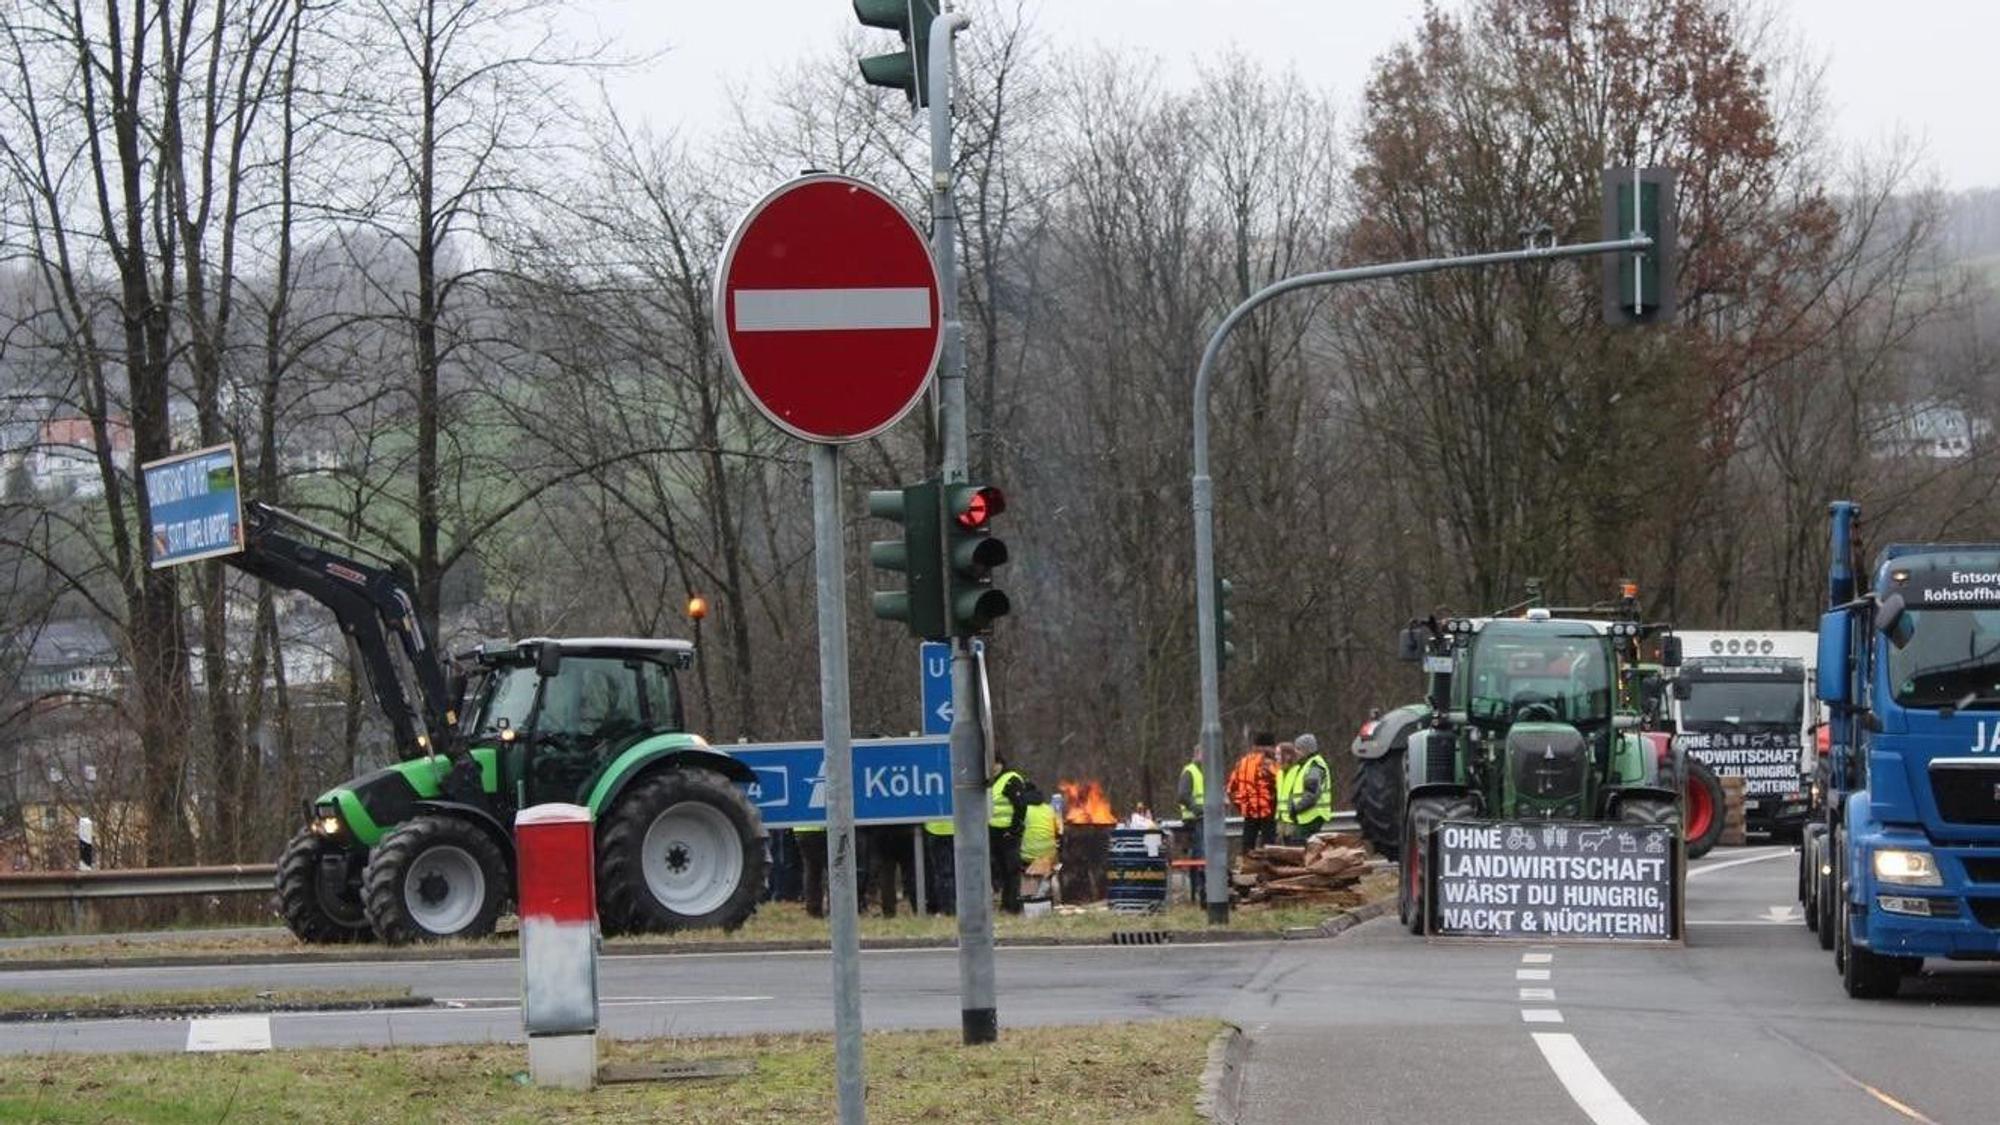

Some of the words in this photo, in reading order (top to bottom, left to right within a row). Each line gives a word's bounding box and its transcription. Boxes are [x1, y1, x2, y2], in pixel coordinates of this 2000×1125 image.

[864, 765, 944, 798] Köln
[1444, 827, 1502, 850] OHNE
[1443, 854, 1665, 882] LANDWIRTSCHAFT
[1444, 879, 1521, 905] WÄRST
[1528, 884, 1557, 905] DU
[1564, 885, 1665, 912] HUNGRIG,
[1443, 908, 1515, 930] NACKT
[1520, 910, 1537, 932] &
[1543, 907, 1665, 934] NÜCHTERN!
